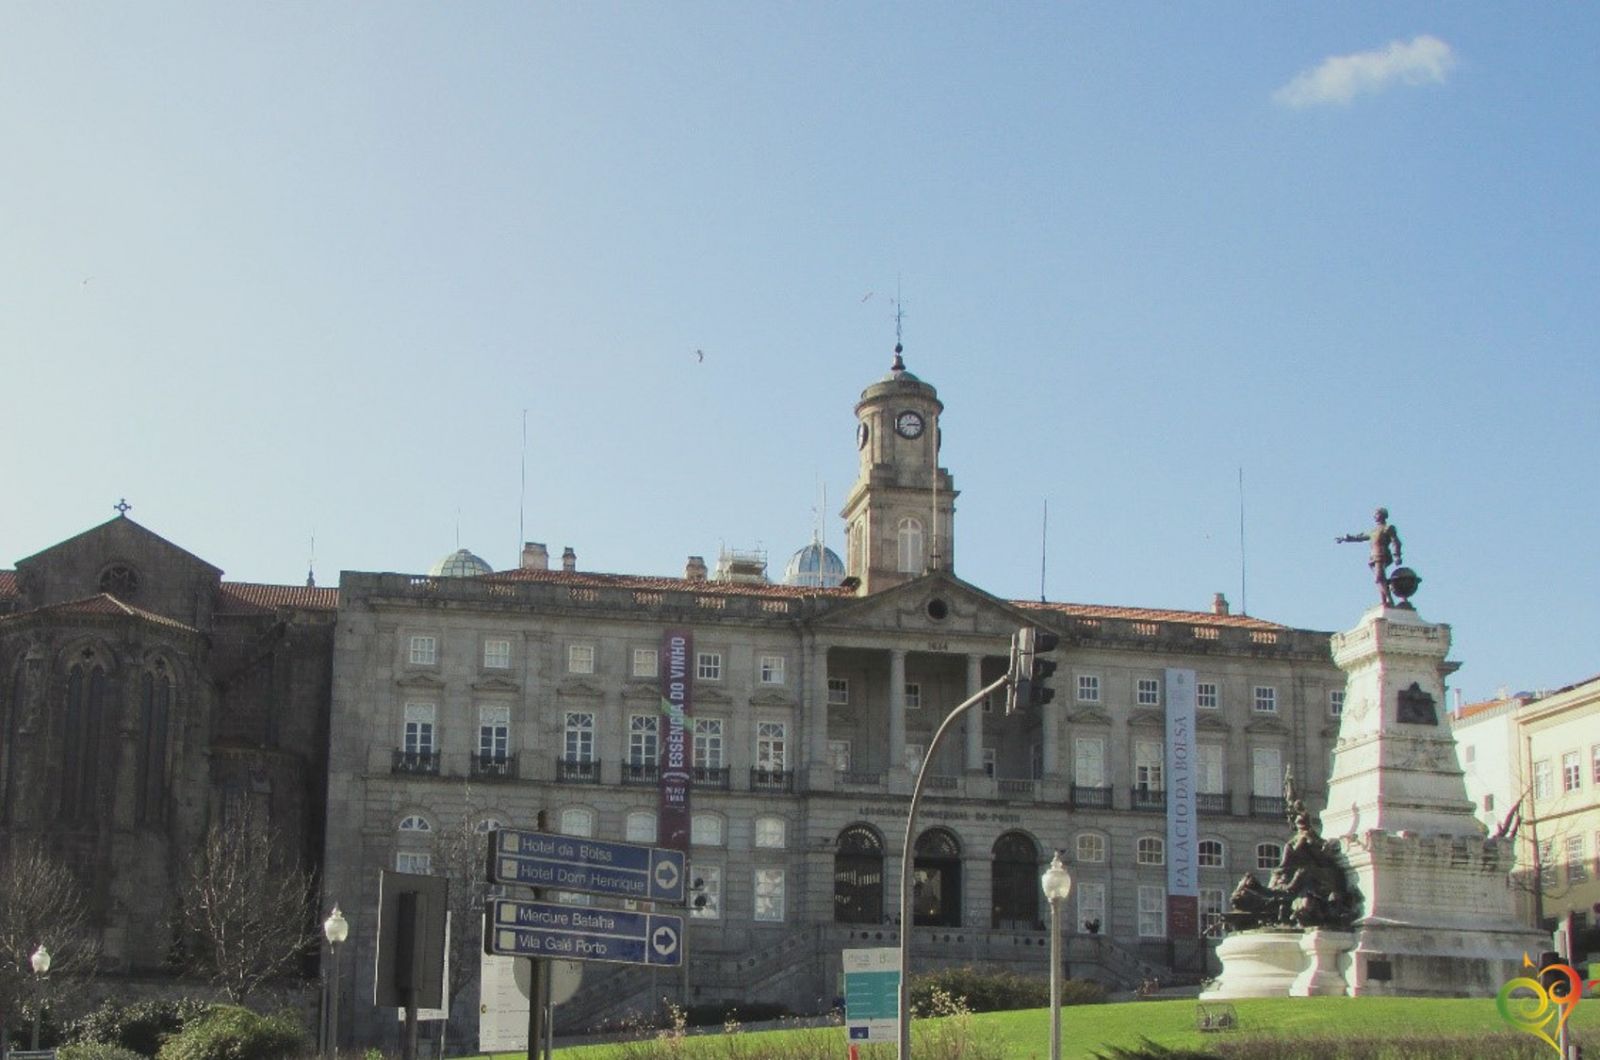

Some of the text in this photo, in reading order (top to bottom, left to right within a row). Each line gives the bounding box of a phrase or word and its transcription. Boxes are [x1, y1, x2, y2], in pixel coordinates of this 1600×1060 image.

[670, 637, 686, 678] VINHO
[670, 683, 685, 699] DO
[667, 703, 685, 767] ESSÊNCIA
[1174, 715, 1188, 770] BOLSA
[1175, 776, 1189, 801] DA
[522, 838, 612, 862] Hotel da Bolsa
[521, 864, 645, 891] Hotel Dom Henrique
[520, 907, 615, 929] Mercure Batalha
[519, 934, 607, 955] Vila Galé Porto
